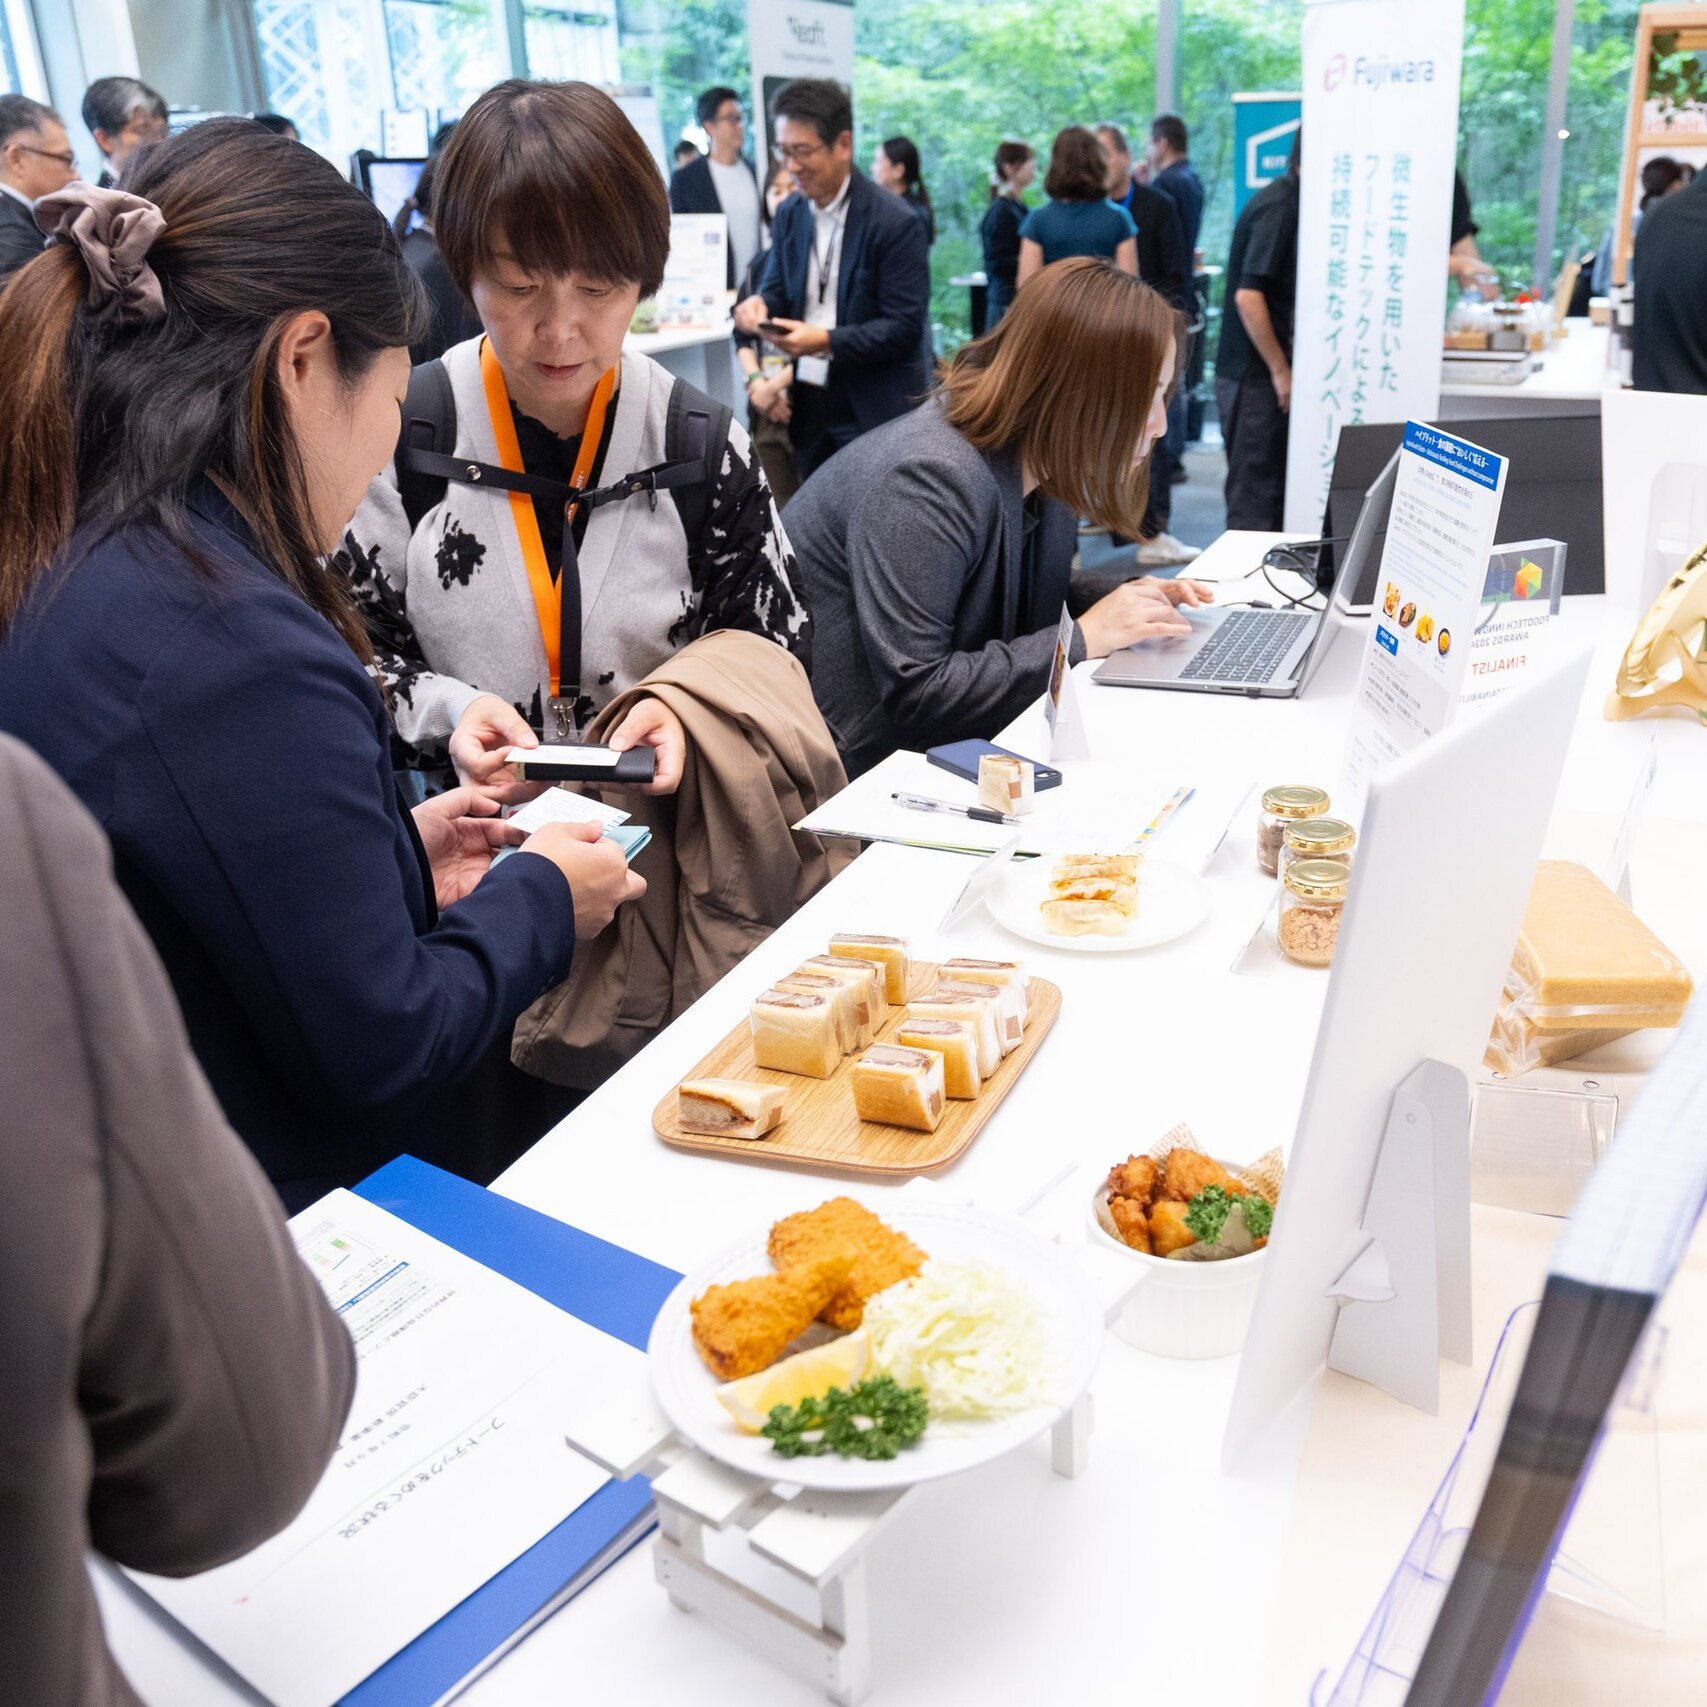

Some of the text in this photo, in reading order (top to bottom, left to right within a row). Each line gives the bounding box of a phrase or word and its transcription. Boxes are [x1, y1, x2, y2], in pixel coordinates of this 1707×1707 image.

[1353, 56, 1434, 90] Fujiwara
[1350, 153, 1382, 425] フードテックによる
[1379, 153, 1412, 394] 微生物を用いた
